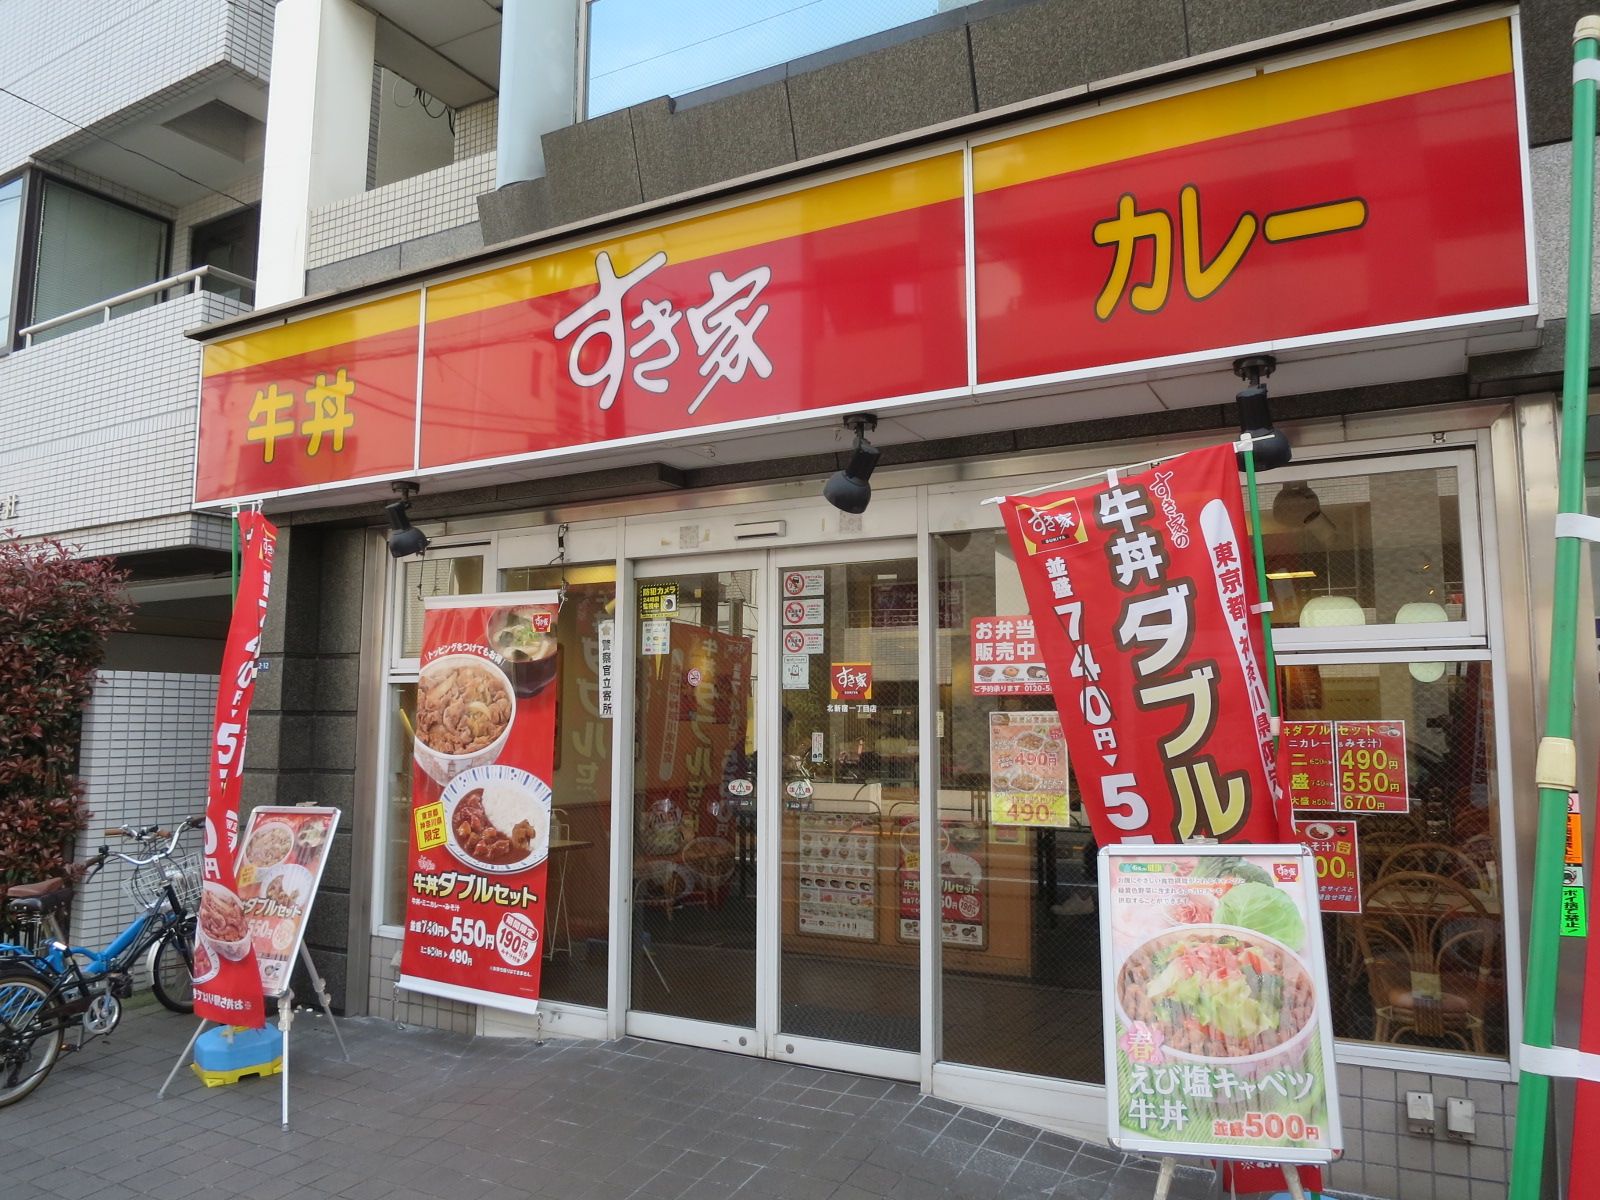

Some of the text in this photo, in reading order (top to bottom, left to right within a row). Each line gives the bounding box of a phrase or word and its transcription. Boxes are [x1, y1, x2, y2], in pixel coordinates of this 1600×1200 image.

[1092, 184, 1369, 321] カレー
[554, 251, 773, 414] すき家
[246, 369, 355, 464] 牛丼
[1027, 507, 1075, 535] すき家
[642, 586, 677, 596] 防犯カメラ
[975, 619, 1036, 639] お弁当
[975, 641, 1036, 662] 販売中
[602, 639, 612, 715] 警察官立寄所
[836, 666, 867, 690] すき家
[1024, 685, 1053, 693] 0120-5
[827, 704, 877, 713] 北新宿一丁目店
[1341, 750, 1398, 770] 490円
[1342, 772, 1400, 792] 550円
[1343, 795, 1385, 810] 670円
[412, 871, 538, 908] 牛丼ダブルセット
[450, 916, 495, 950] 550円
[448, 948, 473, 967] 490円
[1130, 1065, 1314, 1100] えび塩キャベツ
[1128, 1099, 1189, 1131] 牛丼
[1214, 1113, 1320, 1140] 並盛500円
